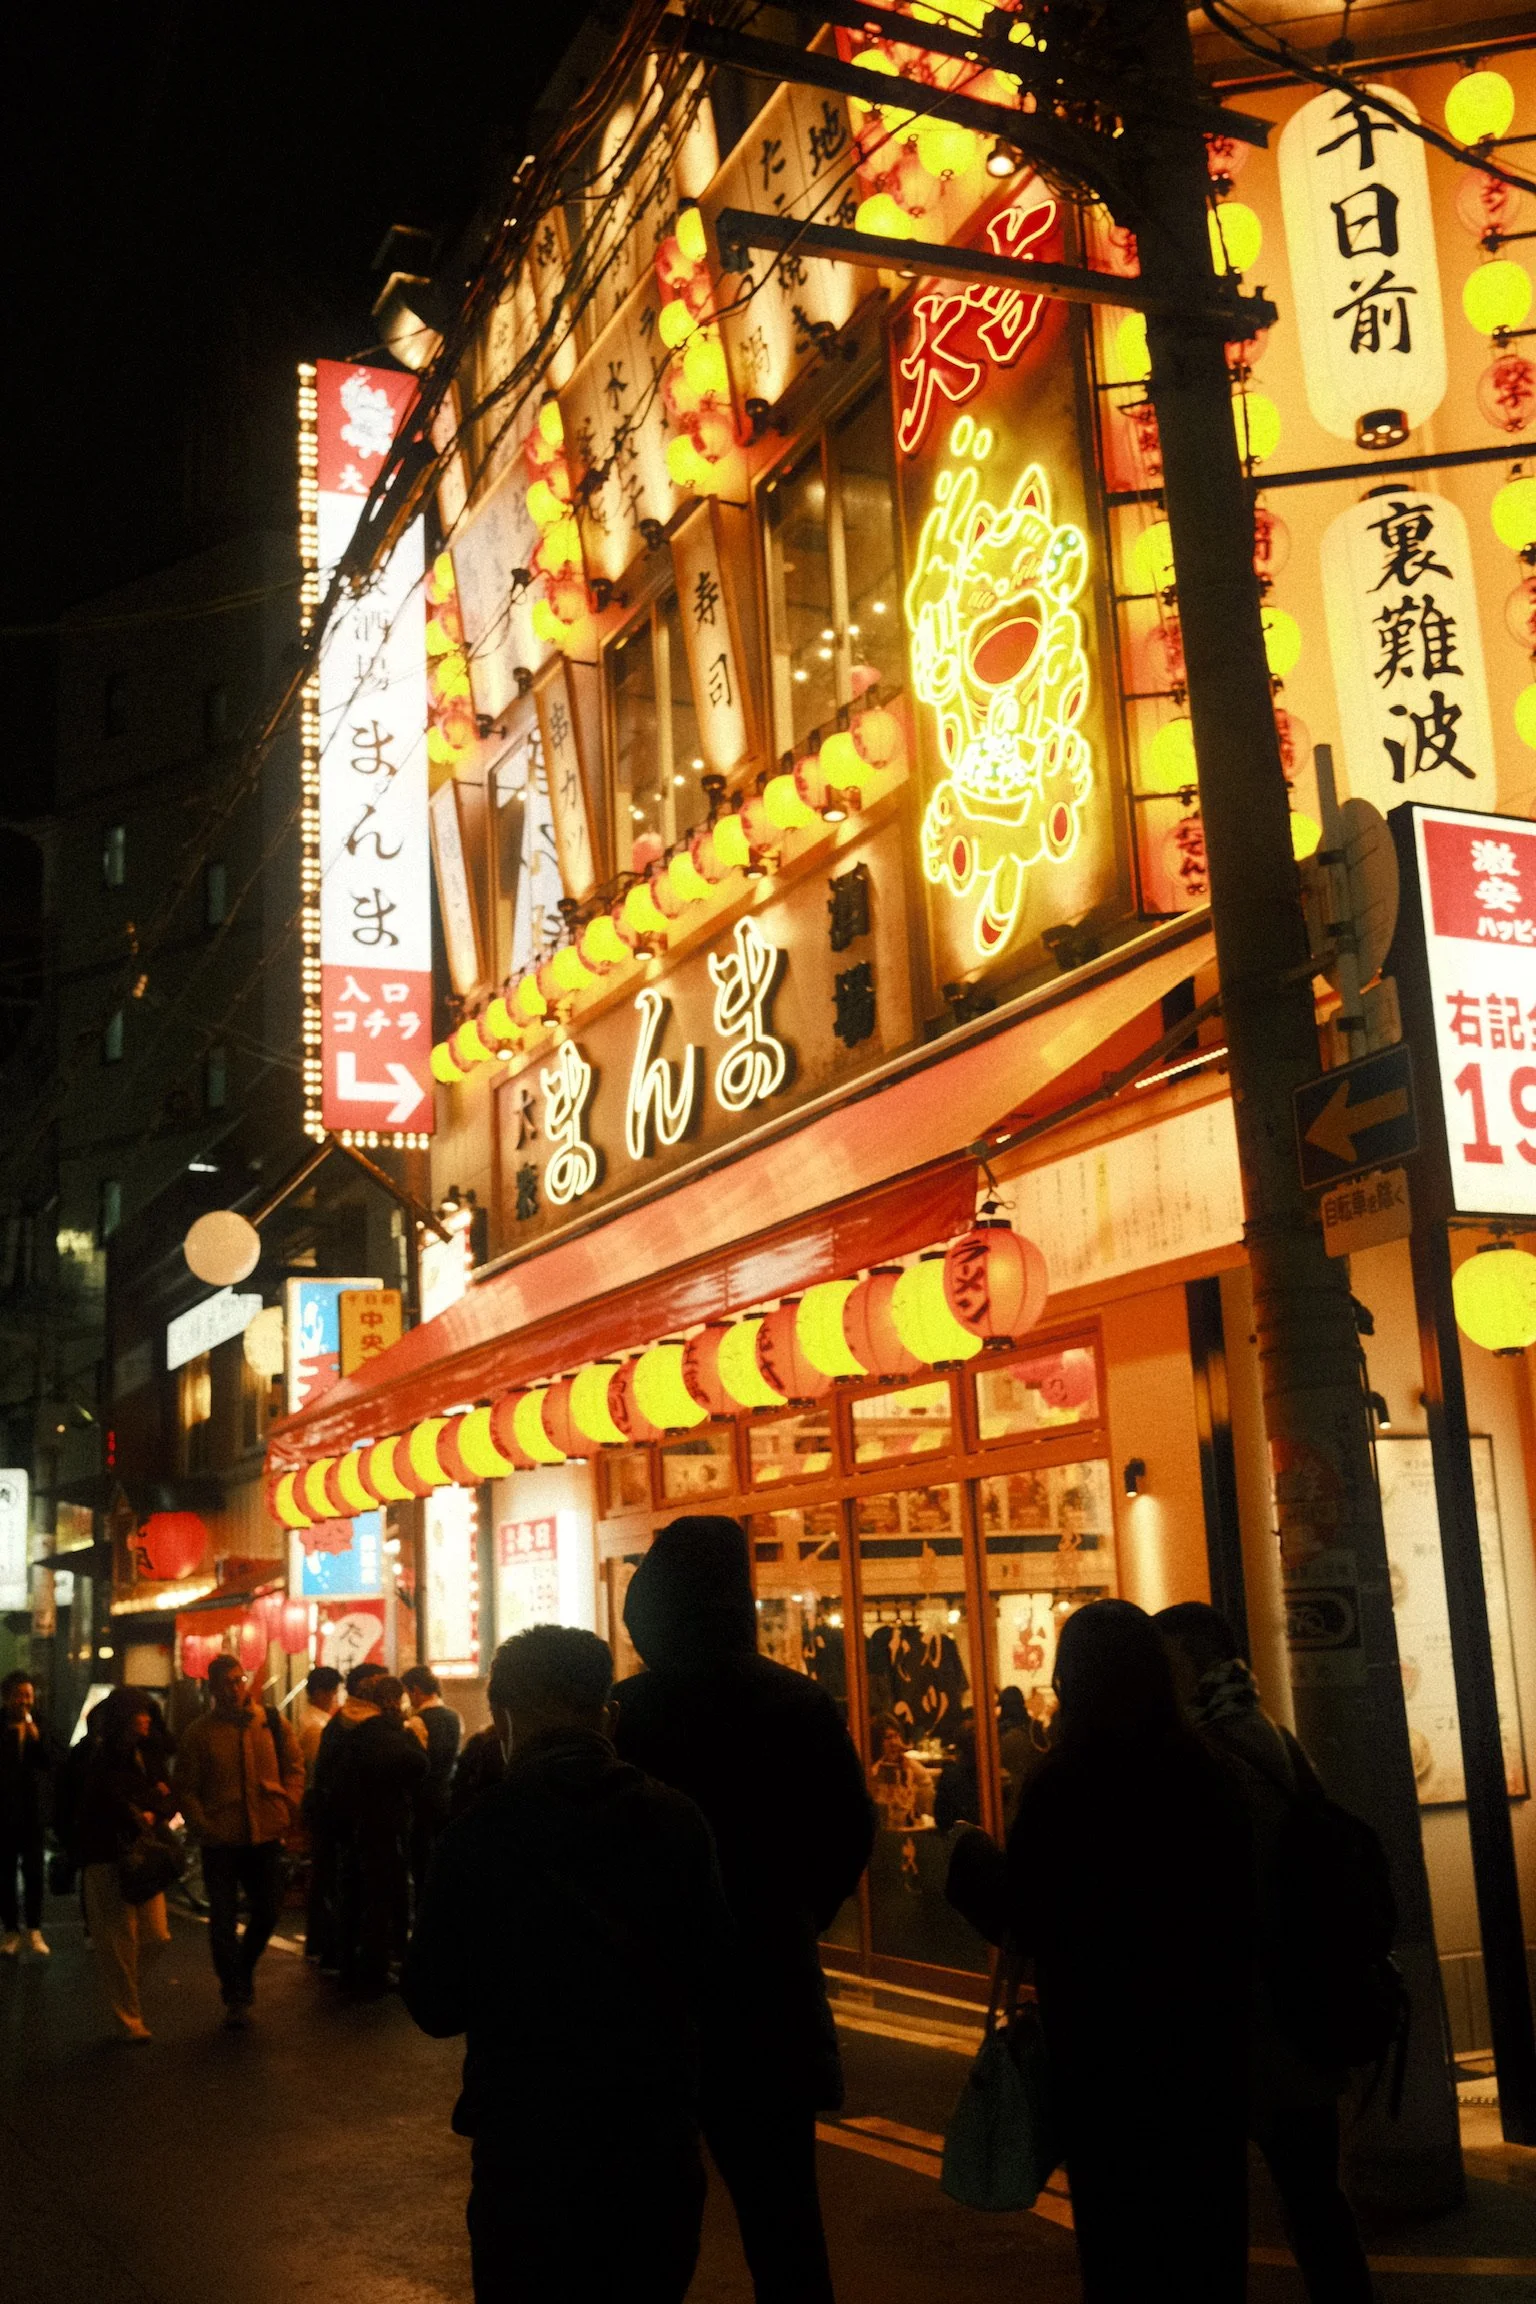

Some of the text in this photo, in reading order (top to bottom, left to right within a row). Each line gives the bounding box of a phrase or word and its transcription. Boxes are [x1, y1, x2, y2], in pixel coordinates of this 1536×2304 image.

[1317, 99, 1418, 355] 千日前
[693, 571, 732, 708] 寿司
[1366, 501, 1477, 784] 裏難波
[346, 719, 403, 949] まんま
[1470, 839, 1523, 915] 激安
[1476, 916, 1536, 944] ハッピ
[332, 1010, 422, 1041] コチラ
[339, 974, 411, 1004] 入口
[360, 1310, 385, 1360] 中央
